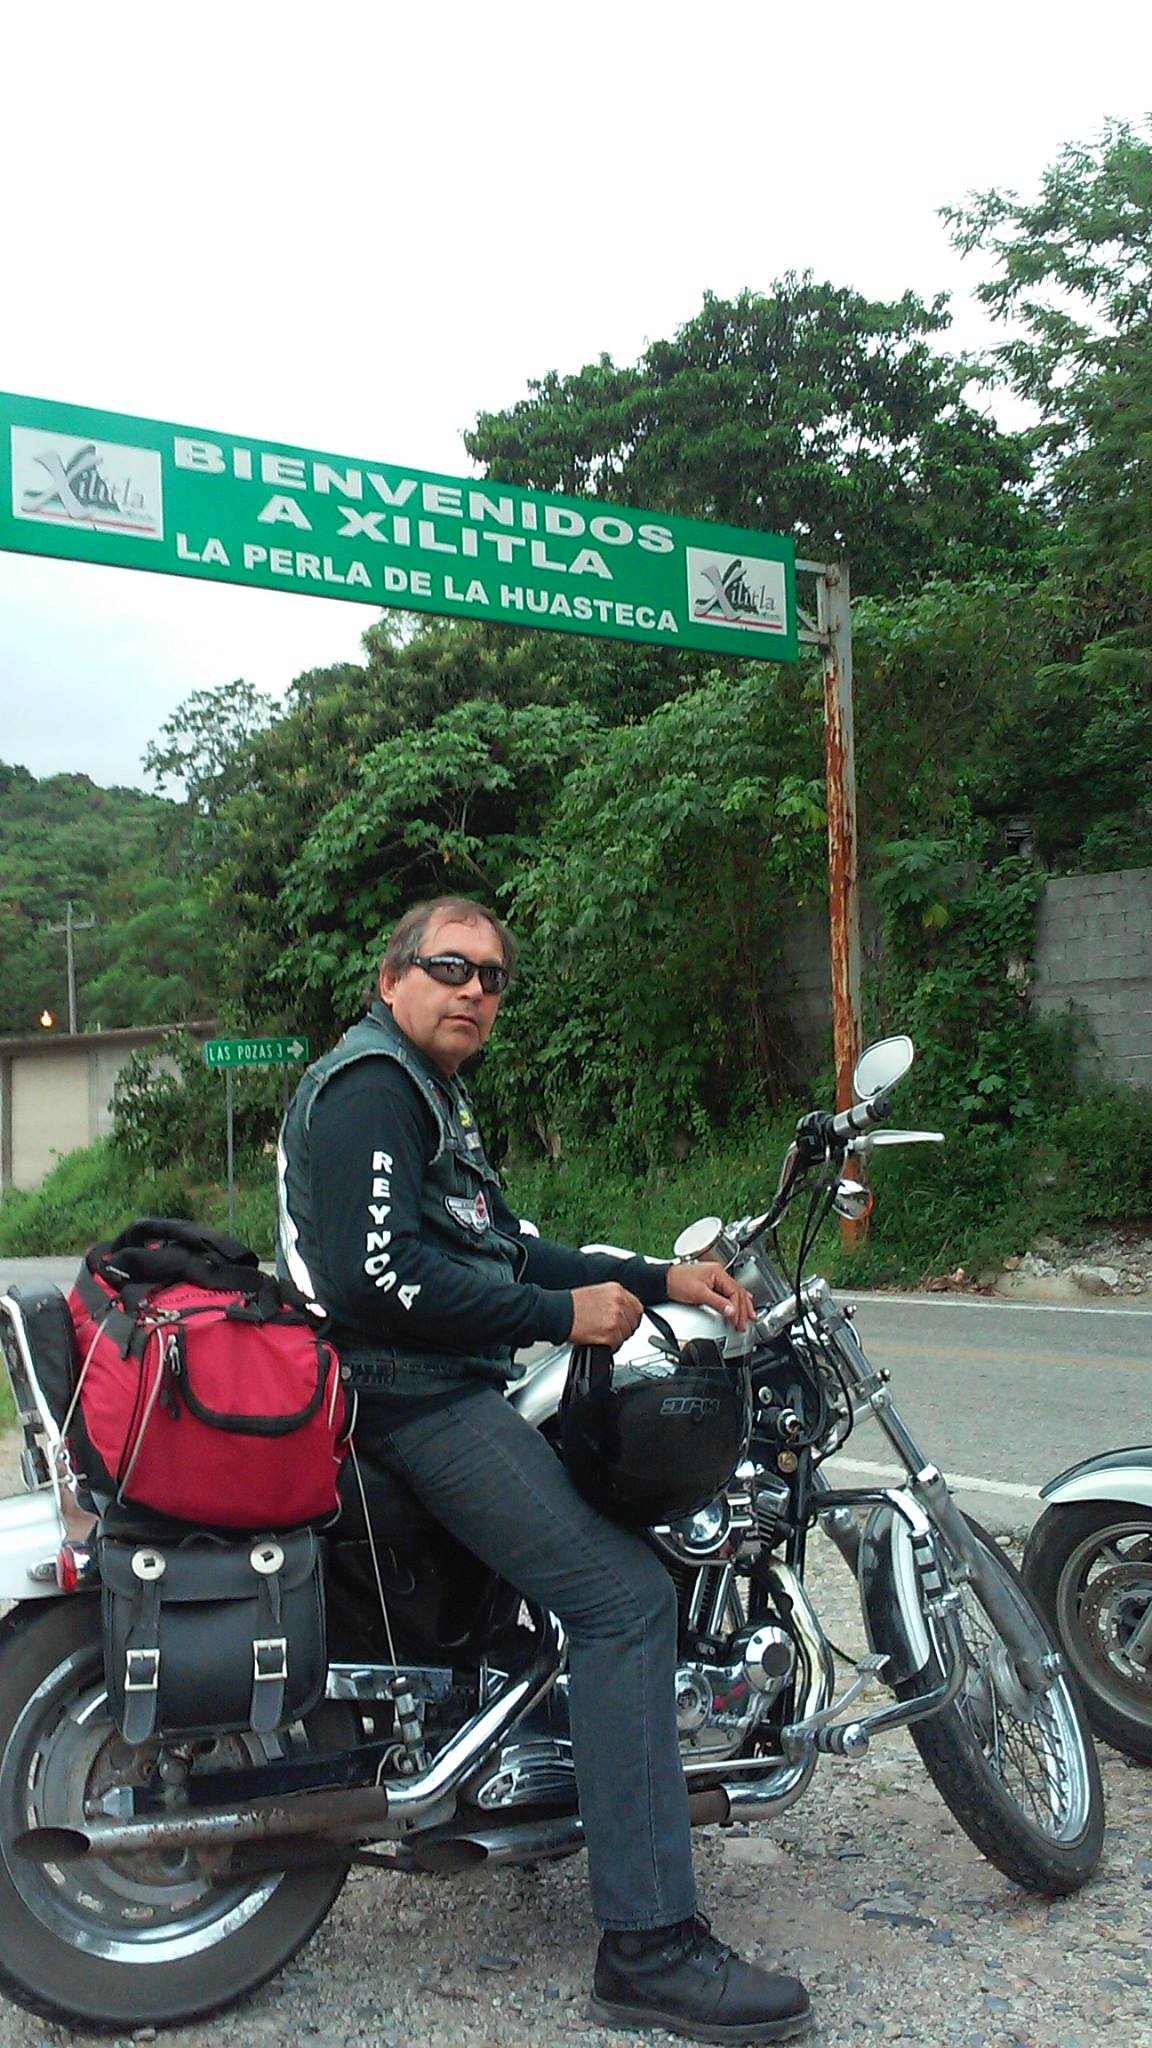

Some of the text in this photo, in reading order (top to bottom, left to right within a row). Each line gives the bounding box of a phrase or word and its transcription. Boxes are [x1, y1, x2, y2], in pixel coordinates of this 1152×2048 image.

[174, 436, 675, 554] BIENVENIDOS
[257, 494, 613, 581] A XILITLA
[176, 532, 679, 633] LA PERLA DE LA HUASTECA
[209, 1043, 283, 1062] LAS POZAS 3
